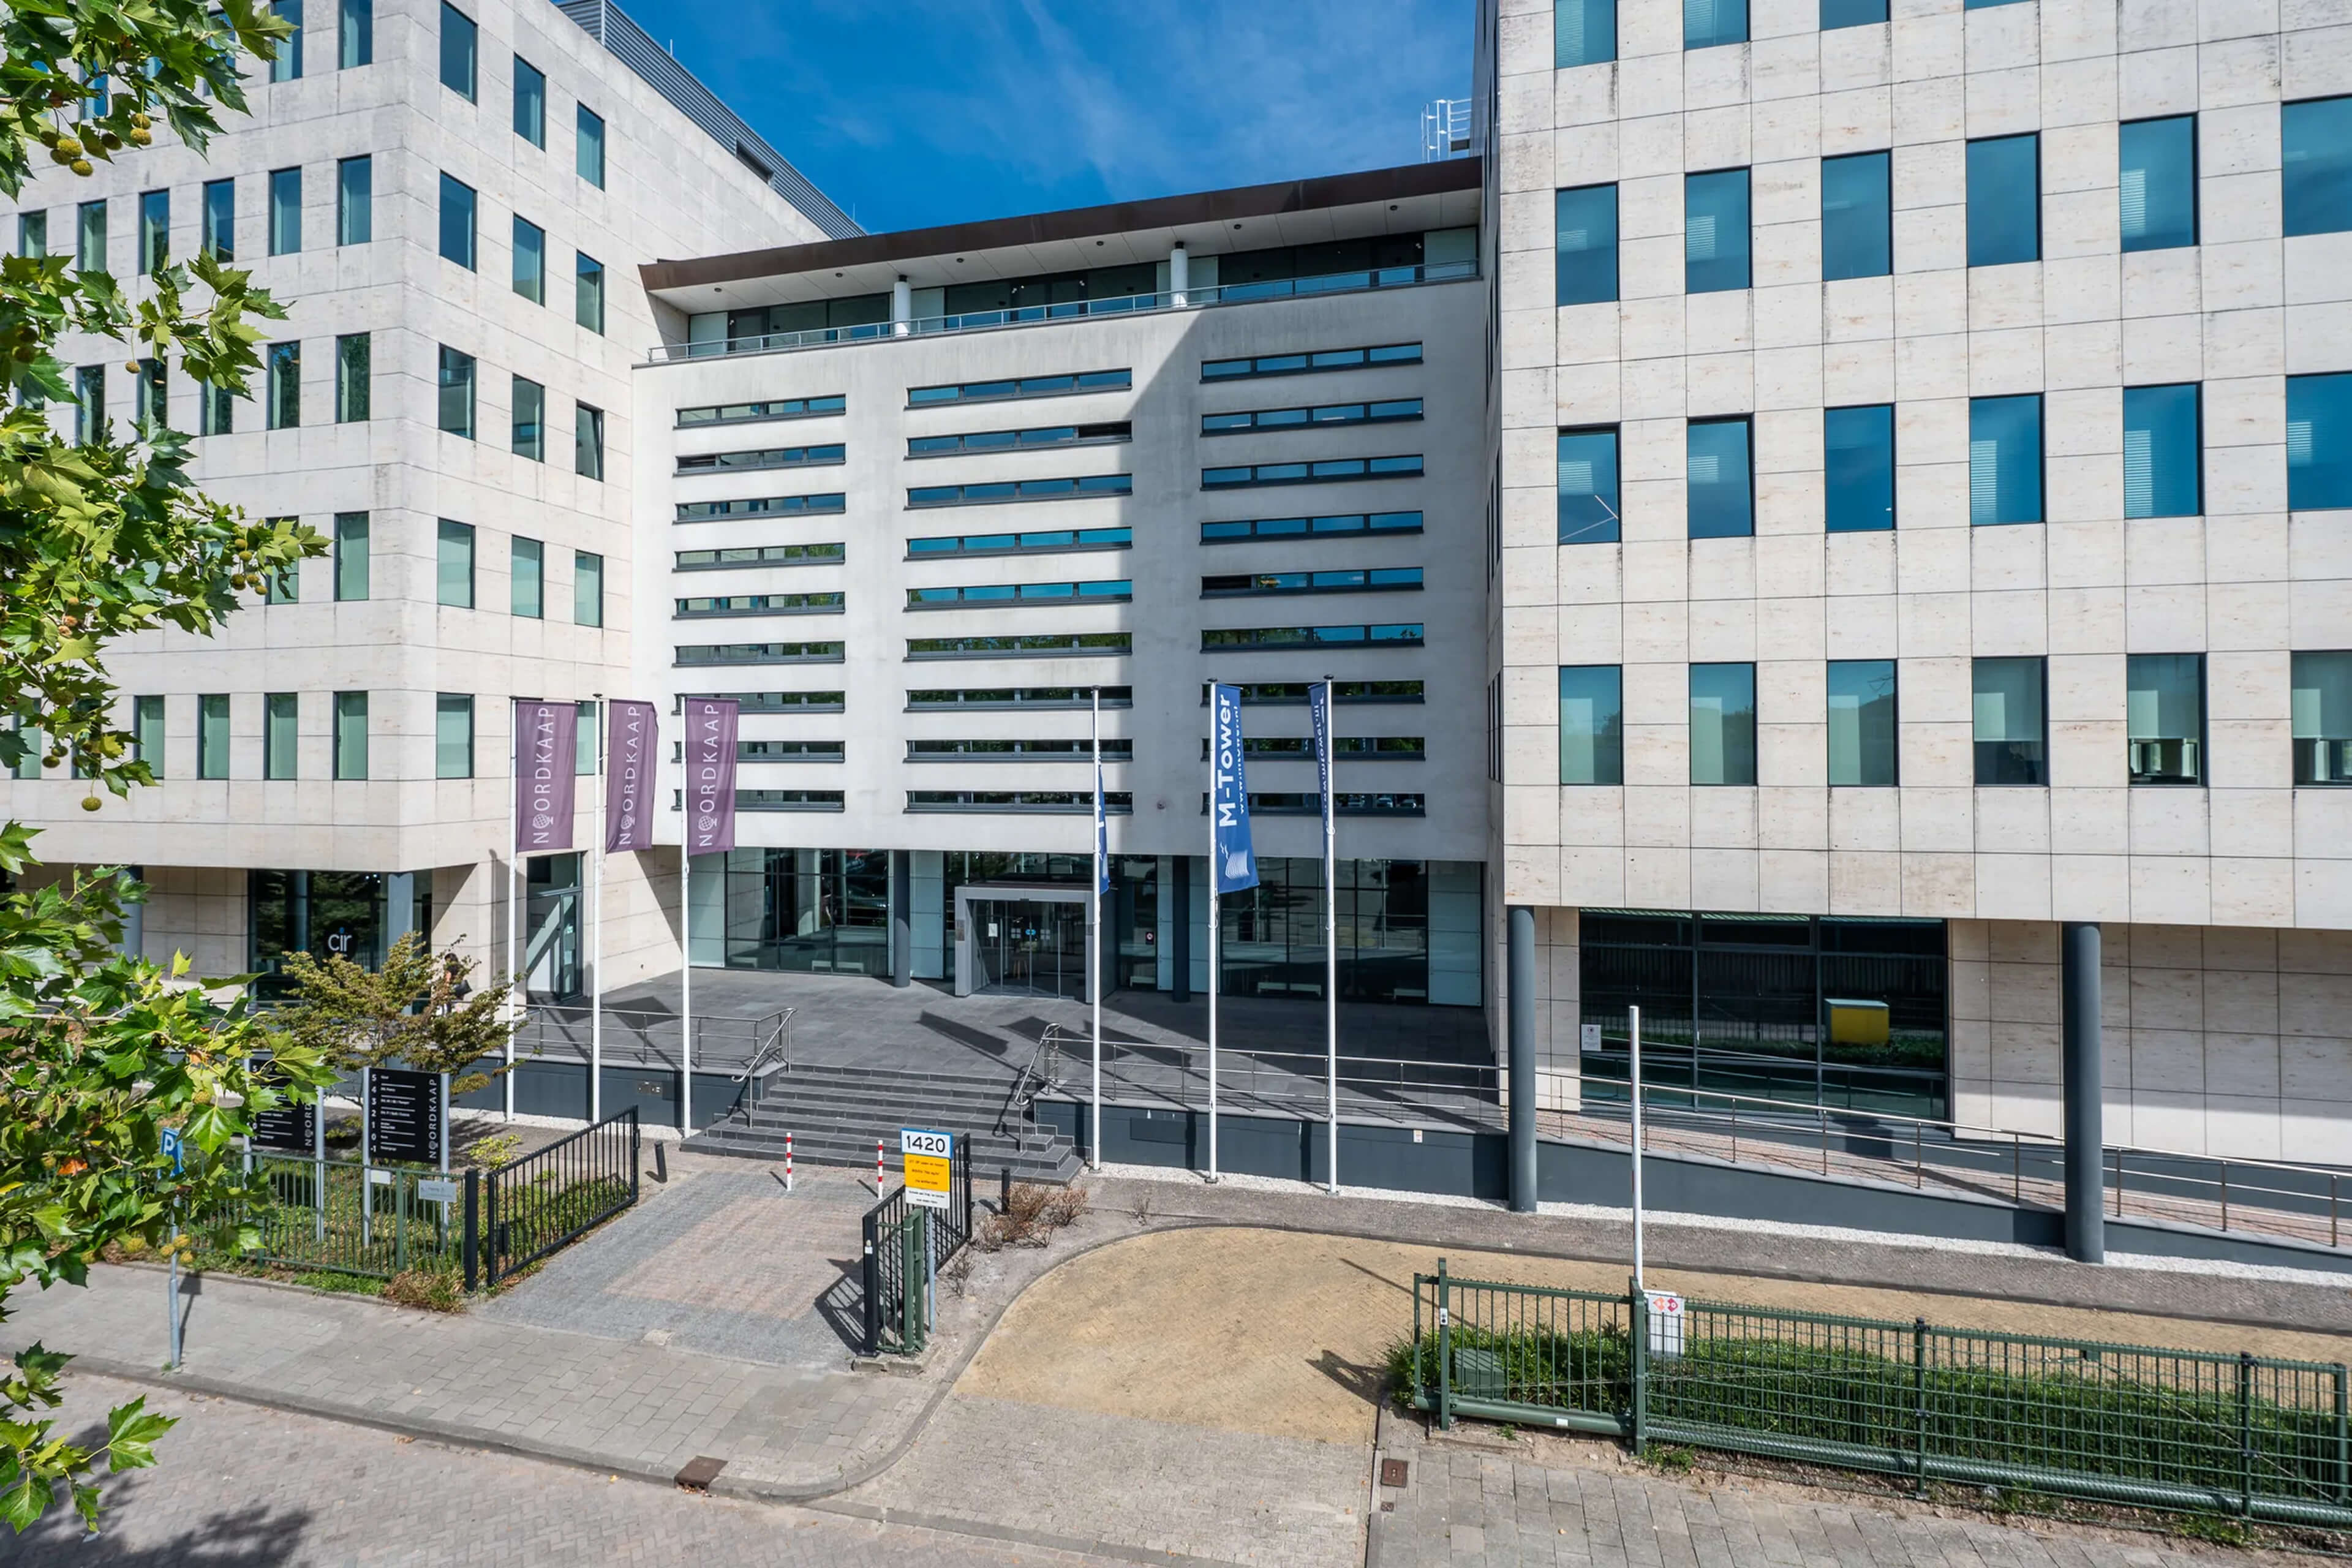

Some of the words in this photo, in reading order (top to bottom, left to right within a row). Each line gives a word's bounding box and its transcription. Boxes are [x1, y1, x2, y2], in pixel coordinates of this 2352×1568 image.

[1218, 695, 1237, 827] M-Tower
[164, 1133, 175, 1155] P
[907, 1134, 946, 1153] 1420
